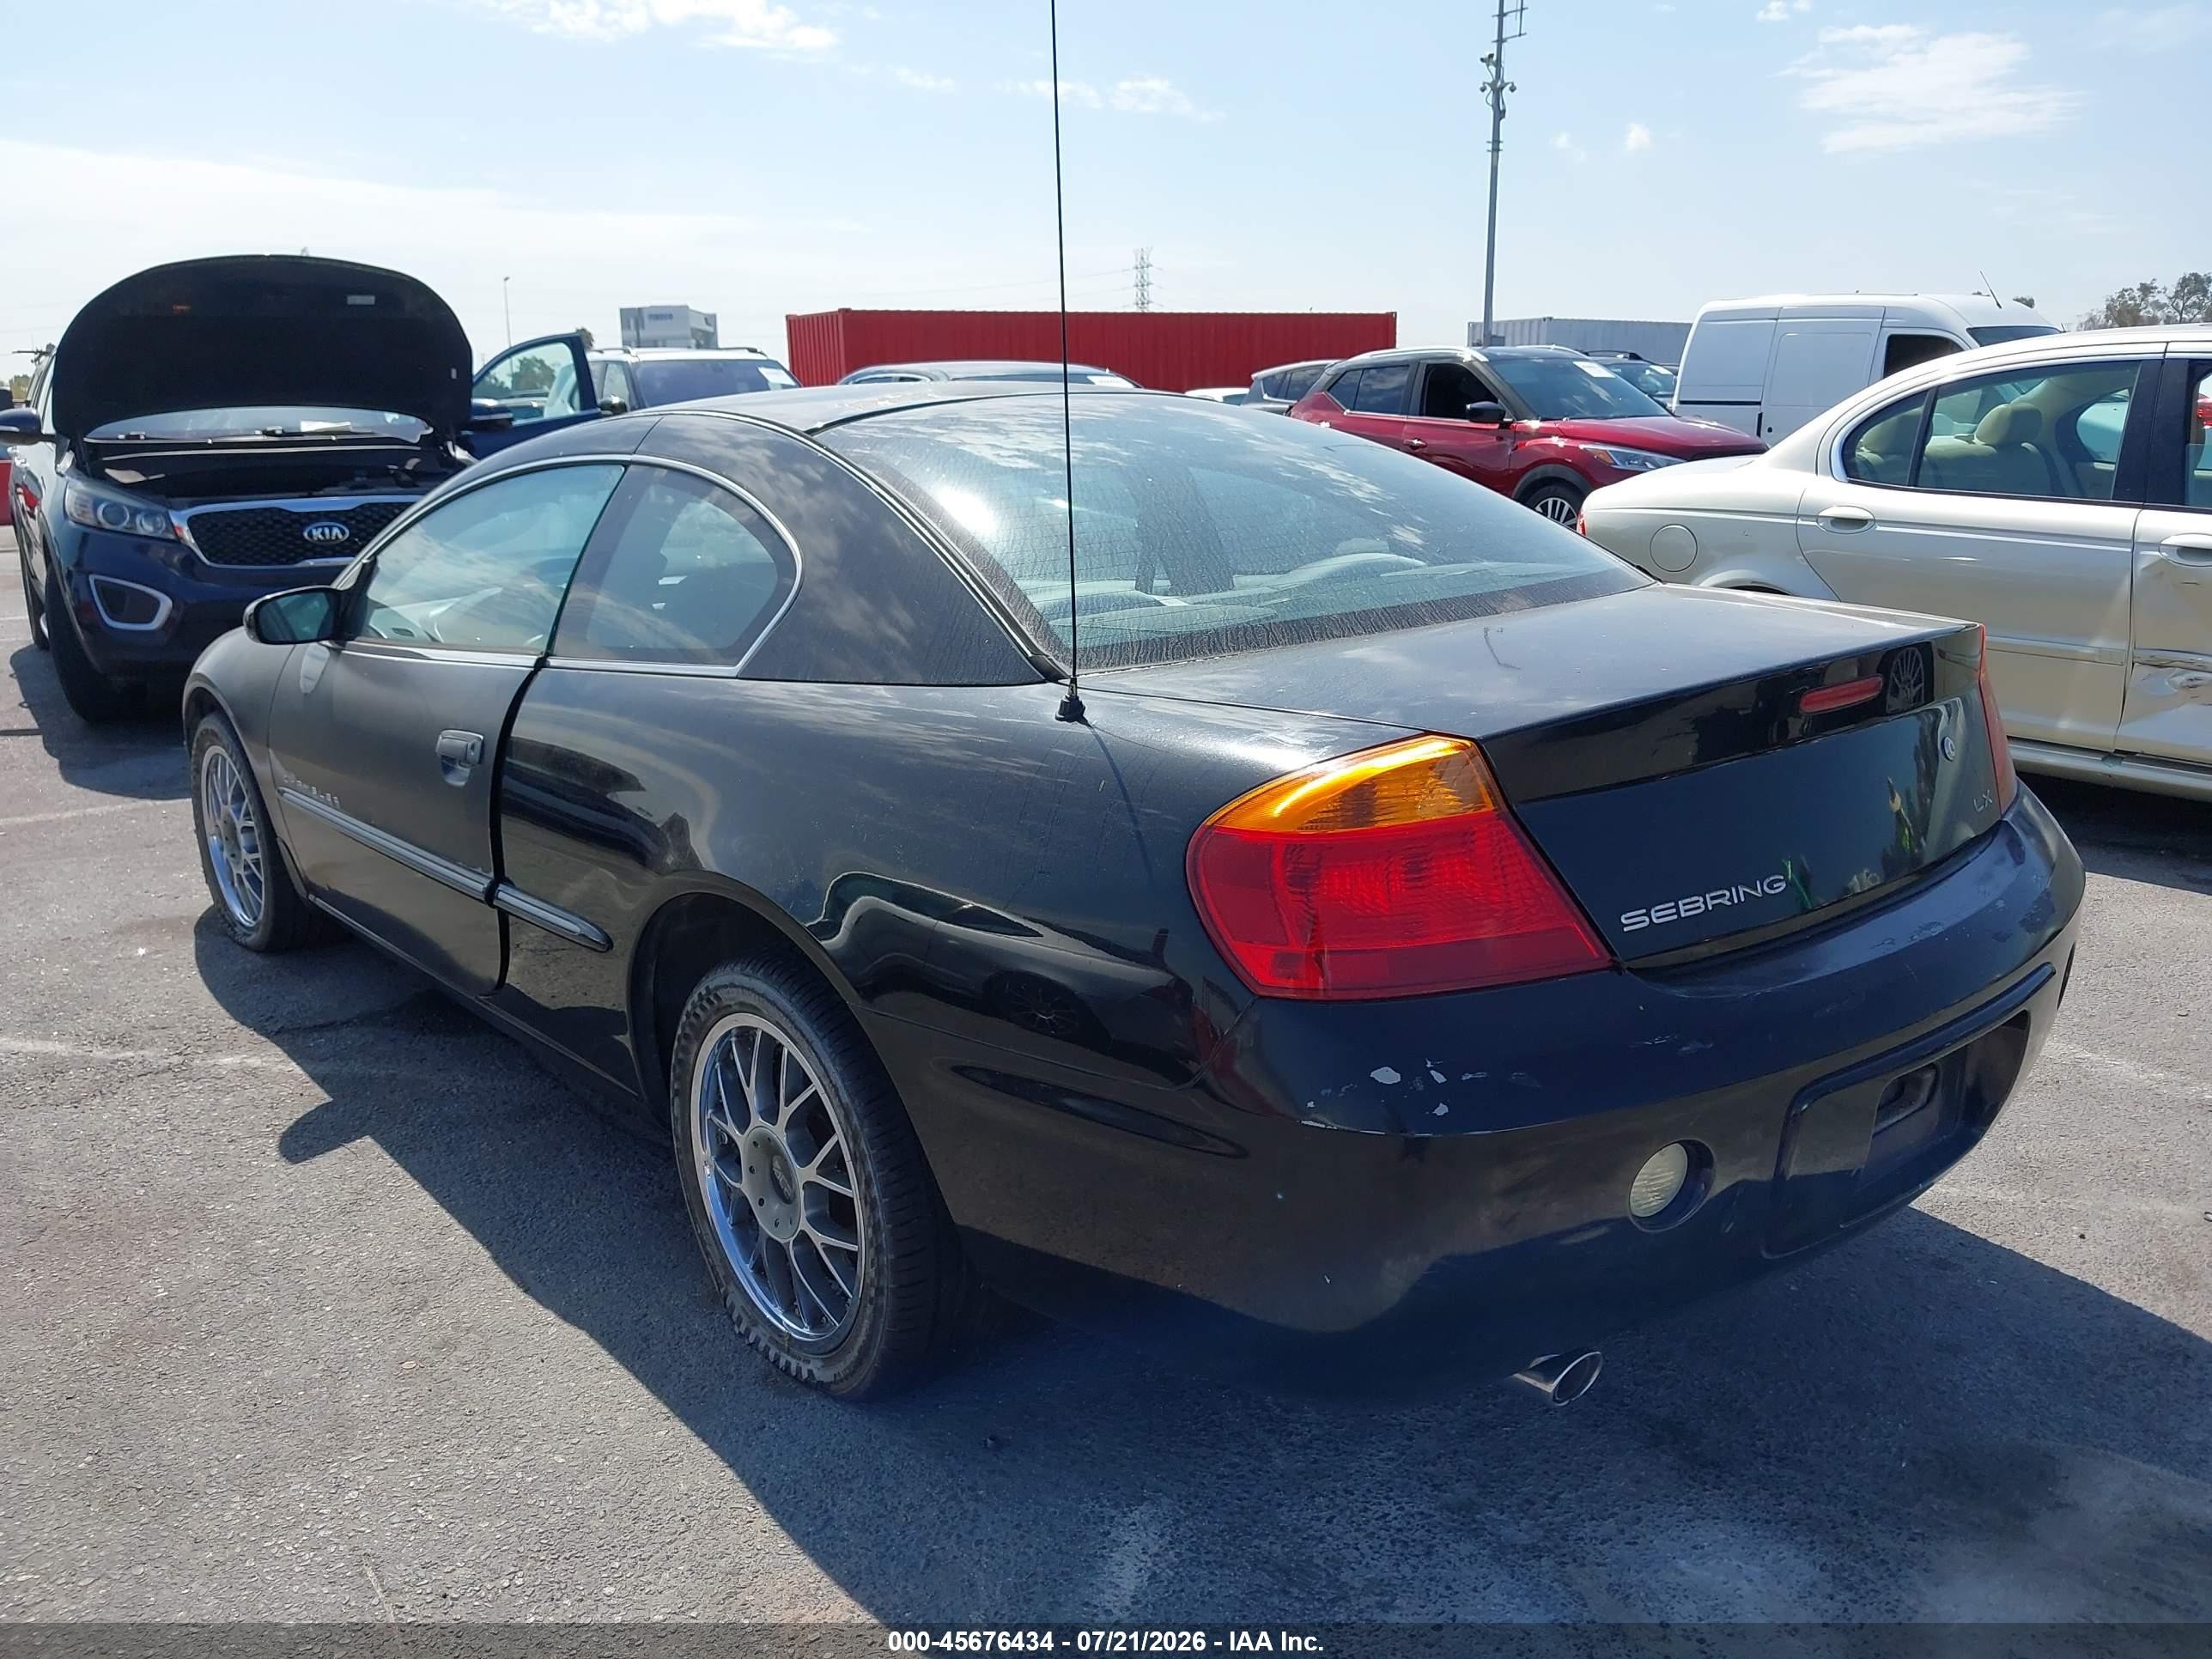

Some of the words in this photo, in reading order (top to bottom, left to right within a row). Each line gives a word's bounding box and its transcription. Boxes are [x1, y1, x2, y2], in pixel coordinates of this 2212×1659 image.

[311, 526, 343, 541] KIA
[1973, 789, 1993, 812] LX
[1620, 874, 1787, 933] SEBRING
